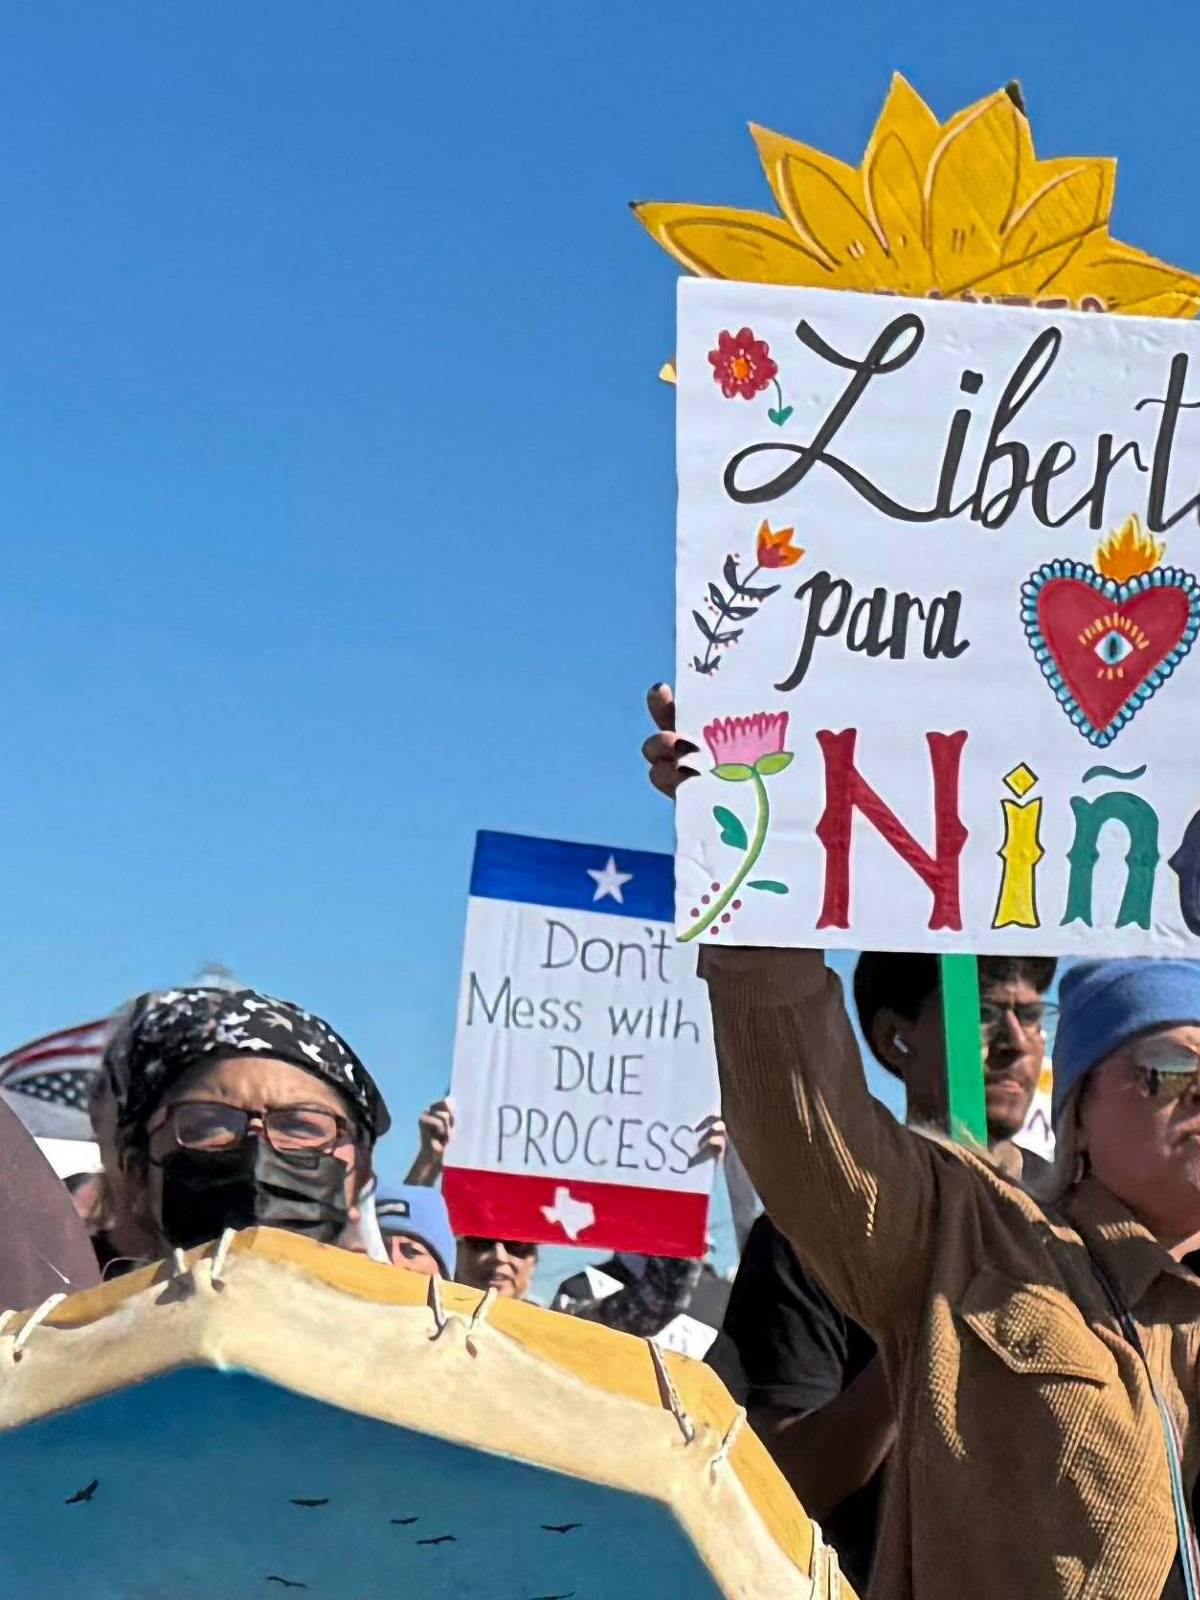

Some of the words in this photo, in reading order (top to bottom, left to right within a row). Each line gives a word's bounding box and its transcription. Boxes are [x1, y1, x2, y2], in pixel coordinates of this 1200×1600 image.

[774, 571, 970, 692] para
[541, 919, 672, 982] Don't
[466, 971, 583, 1033] Mess
[608, 998, 700, 1044] with
[552, 1045, 644, 1096] DUE
[498, 1104, 693, 1175] PROCESS
